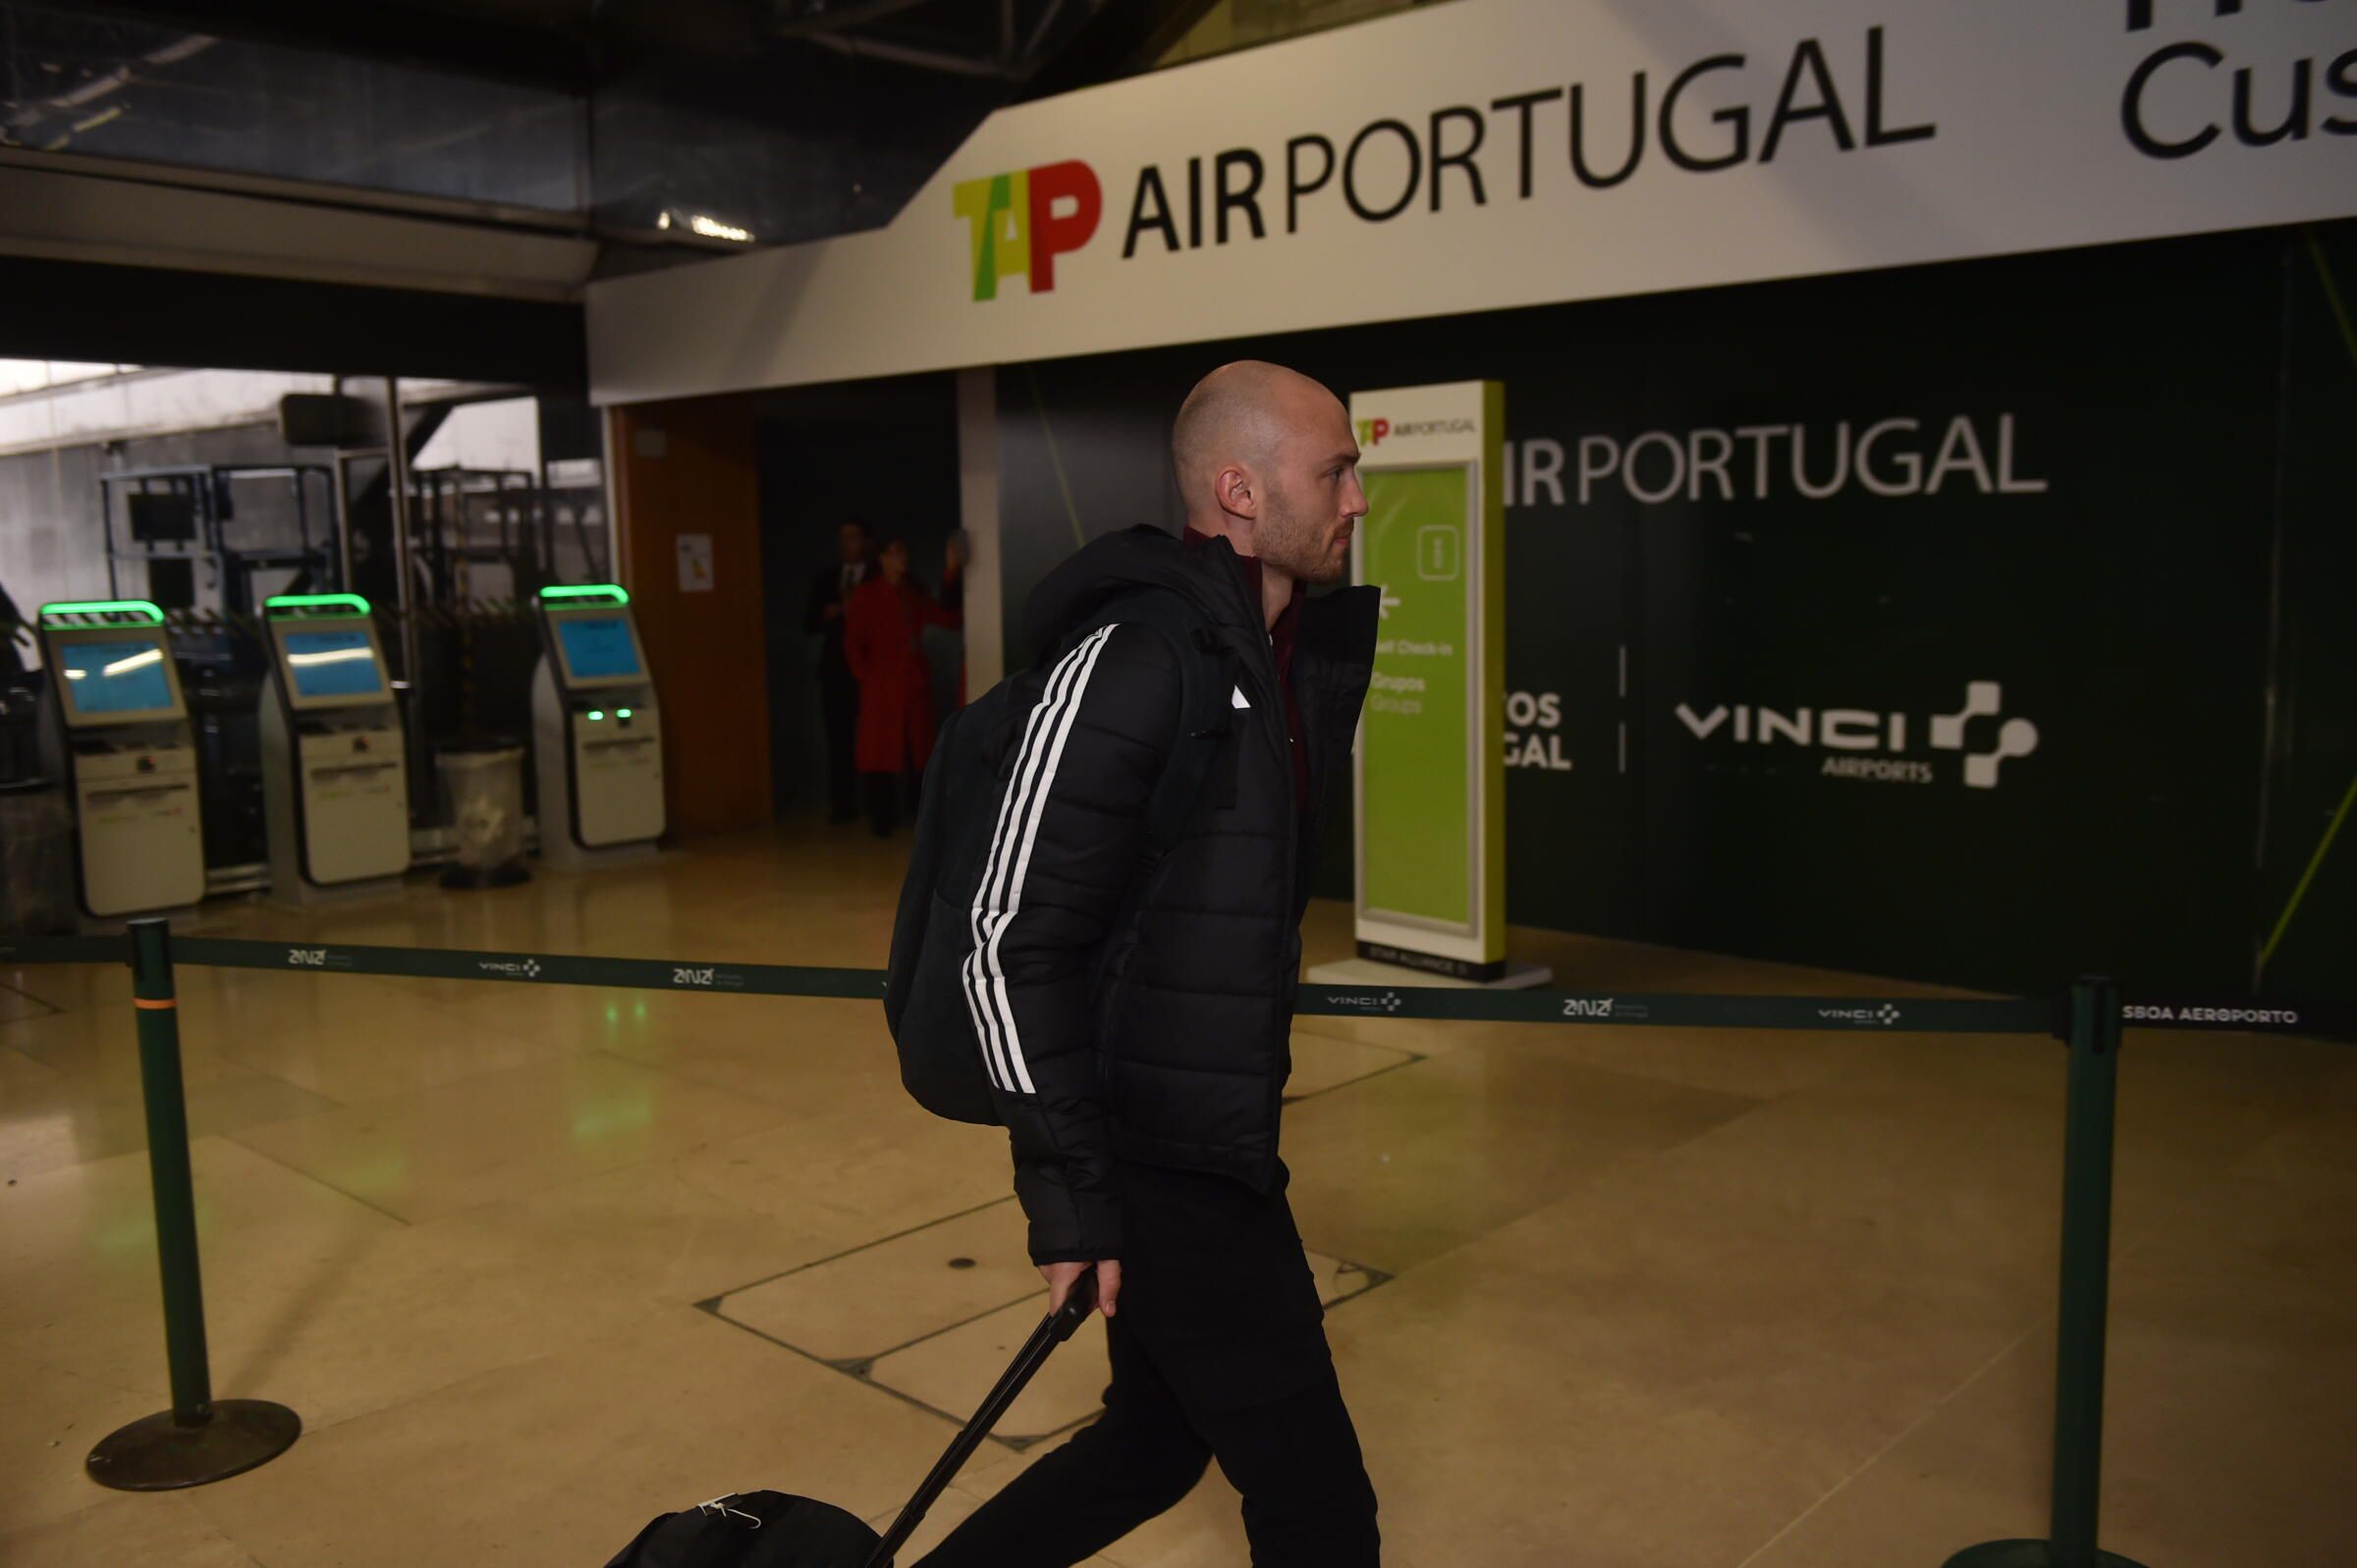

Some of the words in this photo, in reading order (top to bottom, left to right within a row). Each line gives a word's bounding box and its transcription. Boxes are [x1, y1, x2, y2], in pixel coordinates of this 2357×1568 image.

[952, 159, 1103, 302] TAP
[1504, 690, 1562, 730] OS
[1674, 703, 1906, 752] VINCI
[1821, 755, 1933, 784] AIRPORTS
[1327, 996, 1378, 1006] VINCI
[1817, 1008, 1874, 1019] VINCI
[2178, 1007, 2299, 1024] AEROPORTO
